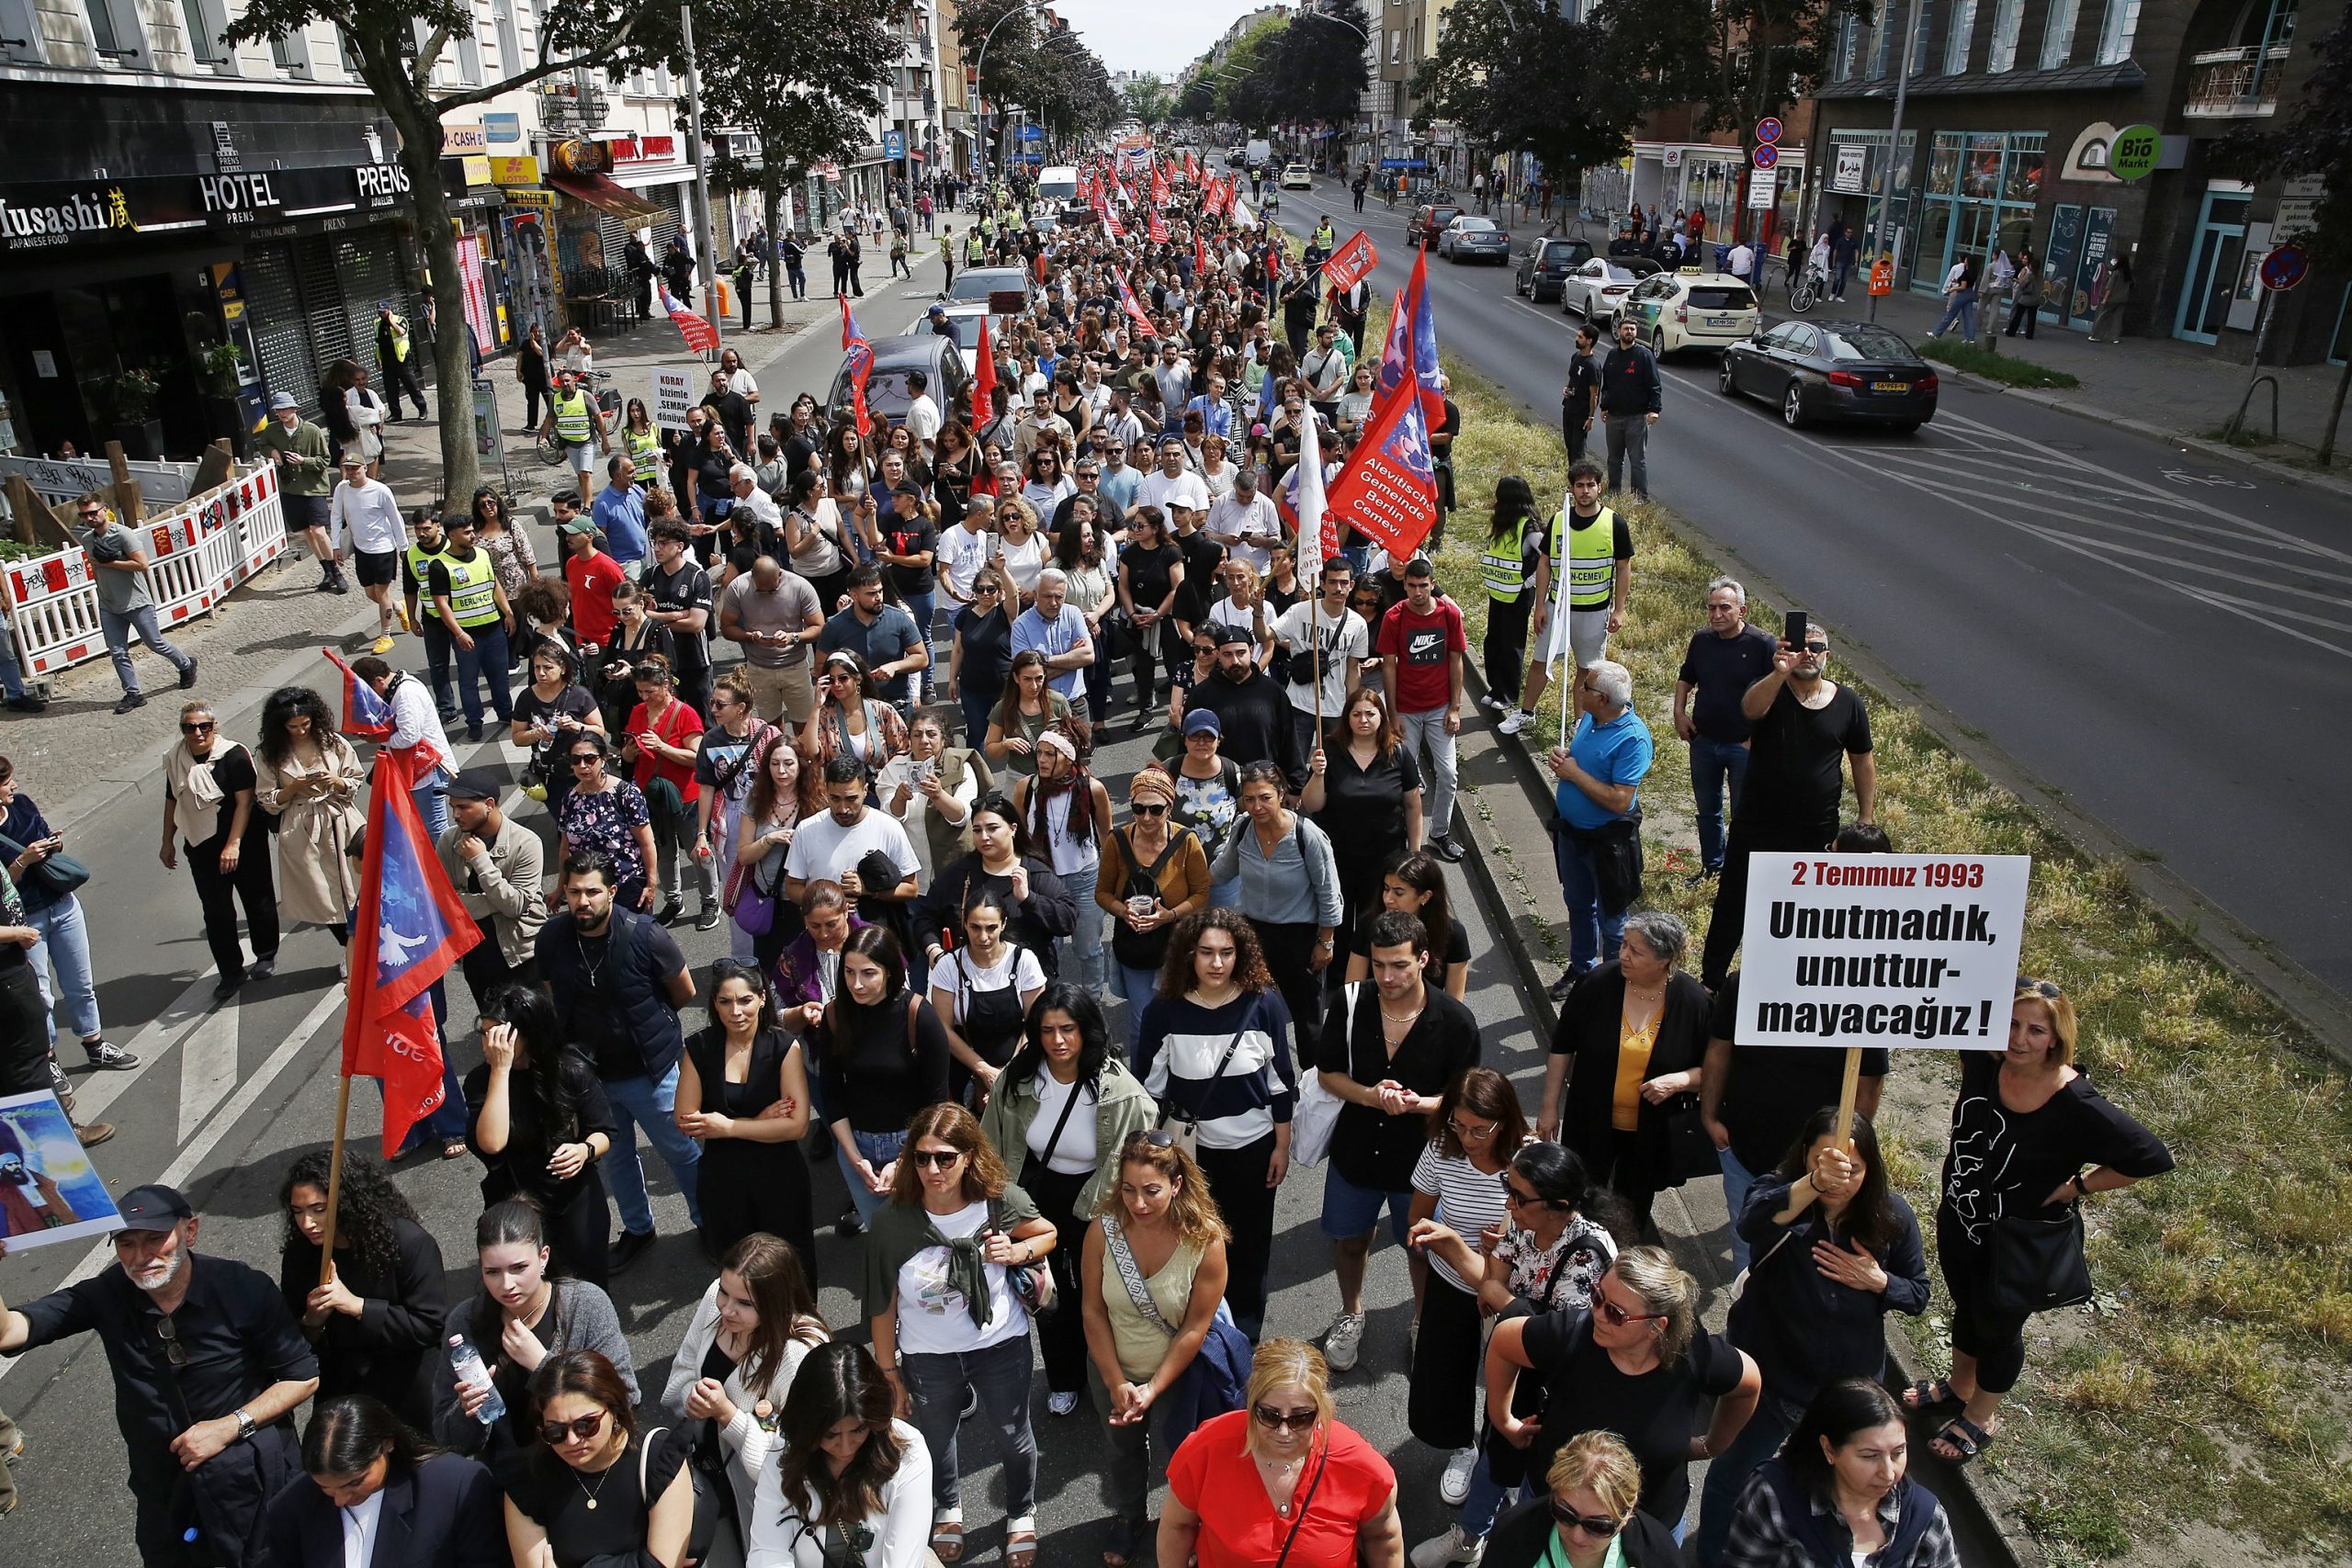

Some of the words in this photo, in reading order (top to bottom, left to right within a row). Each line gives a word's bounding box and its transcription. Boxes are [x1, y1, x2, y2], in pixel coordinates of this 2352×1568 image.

[219, 155, 240, 165] PRENS
[2118, 158, 2149, 169] Markt
[469, 162, 488, 175] LOTTO
[356, 165, 411, 197] PRENS
[503, 175, 529, 183] LOTTO
[198, 173, 280, 211] HOTEL
[458, 198, 474, 207] COFFEE
[226, 211, 254, 224] PRENS
[322, 217, 346, 231] PRENS
[250, 228, 272, 240] ALTIN
[9, 236, 47, 250] JAPANESE
[47, 233, 69, 245] FOOD
[2088, 243, 2106, 252] ARTEN
[660, 375, 684, 386] KORAY
[659, 388, 688, 399] bizimle
[657, 412, 685, 423] dönüyo
[1360, 470, 1425, 521] Gemeinde
[1365, 490, 1405, 523] Berlin
[1353, 499, 1403, 537] Cemevi
[1347, 514, 1385, 545] www.alevi.org
[1570, 570, 1604, 581] N-CEMEVI
[459, 592, 492, 607] BERLIN-CE
[1413, 634, 1437, 647] NIKE
[1792, 862, 1808, 885] 2
[1814, 862, 1917, 886] Temmuz
[1923, 863, 1984, 887] 1993
[1770, 901, 1996, 945] Unutmadık,
[1795, 953, 1961, 988] unuttur-
[1757, 997, 1972, 1040] mayacağız
[1977, 1000, 1993, 1036] !
